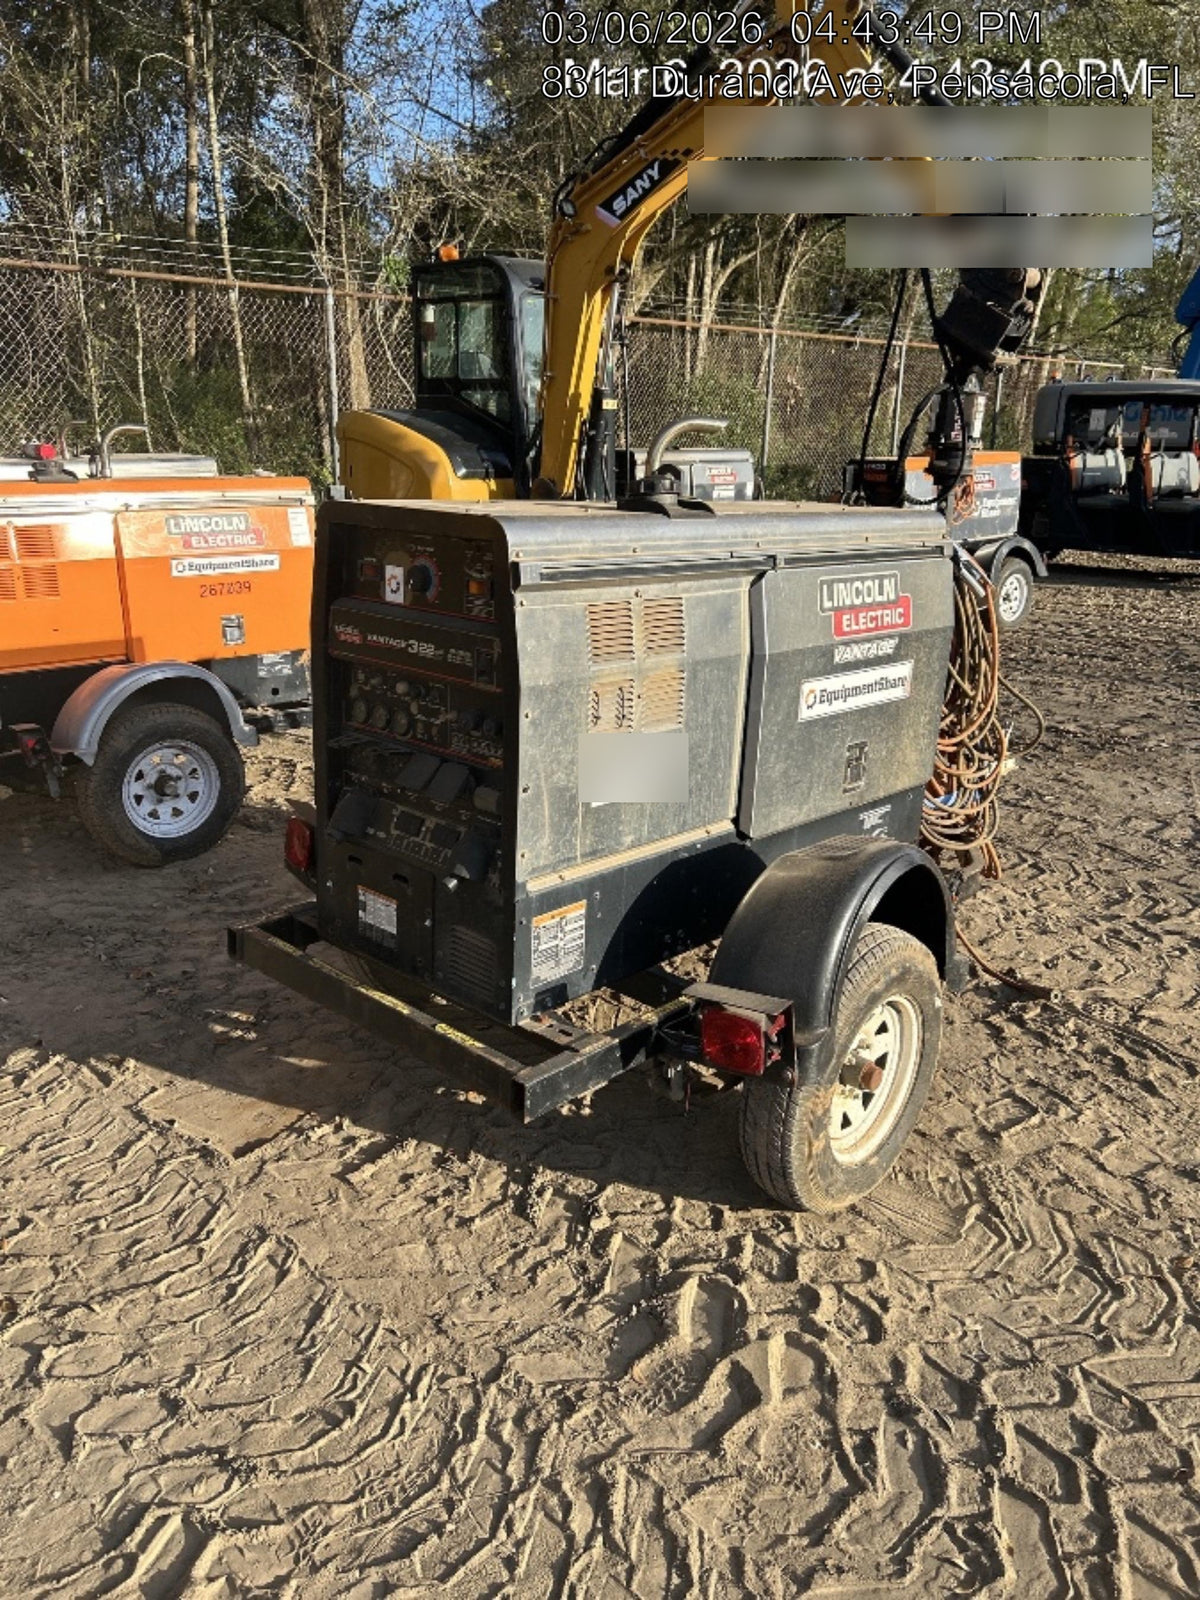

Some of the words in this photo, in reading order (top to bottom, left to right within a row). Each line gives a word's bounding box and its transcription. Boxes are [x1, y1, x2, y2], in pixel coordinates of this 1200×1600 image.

[612, 161, 660, 216] SANY
[169, 516, 247, 534] LINCOLN
[190, 533, 257, 548] ELECTRIC
[187, 559, 275, 573] EquipmentShare
[821, 577, 896, 609] LINCOLN
[842, 607, 905, 633] ELECTRIC
[834, 637, 899, 665] VANTAGE
[817, 676, 907, 706] EquipmentShare
